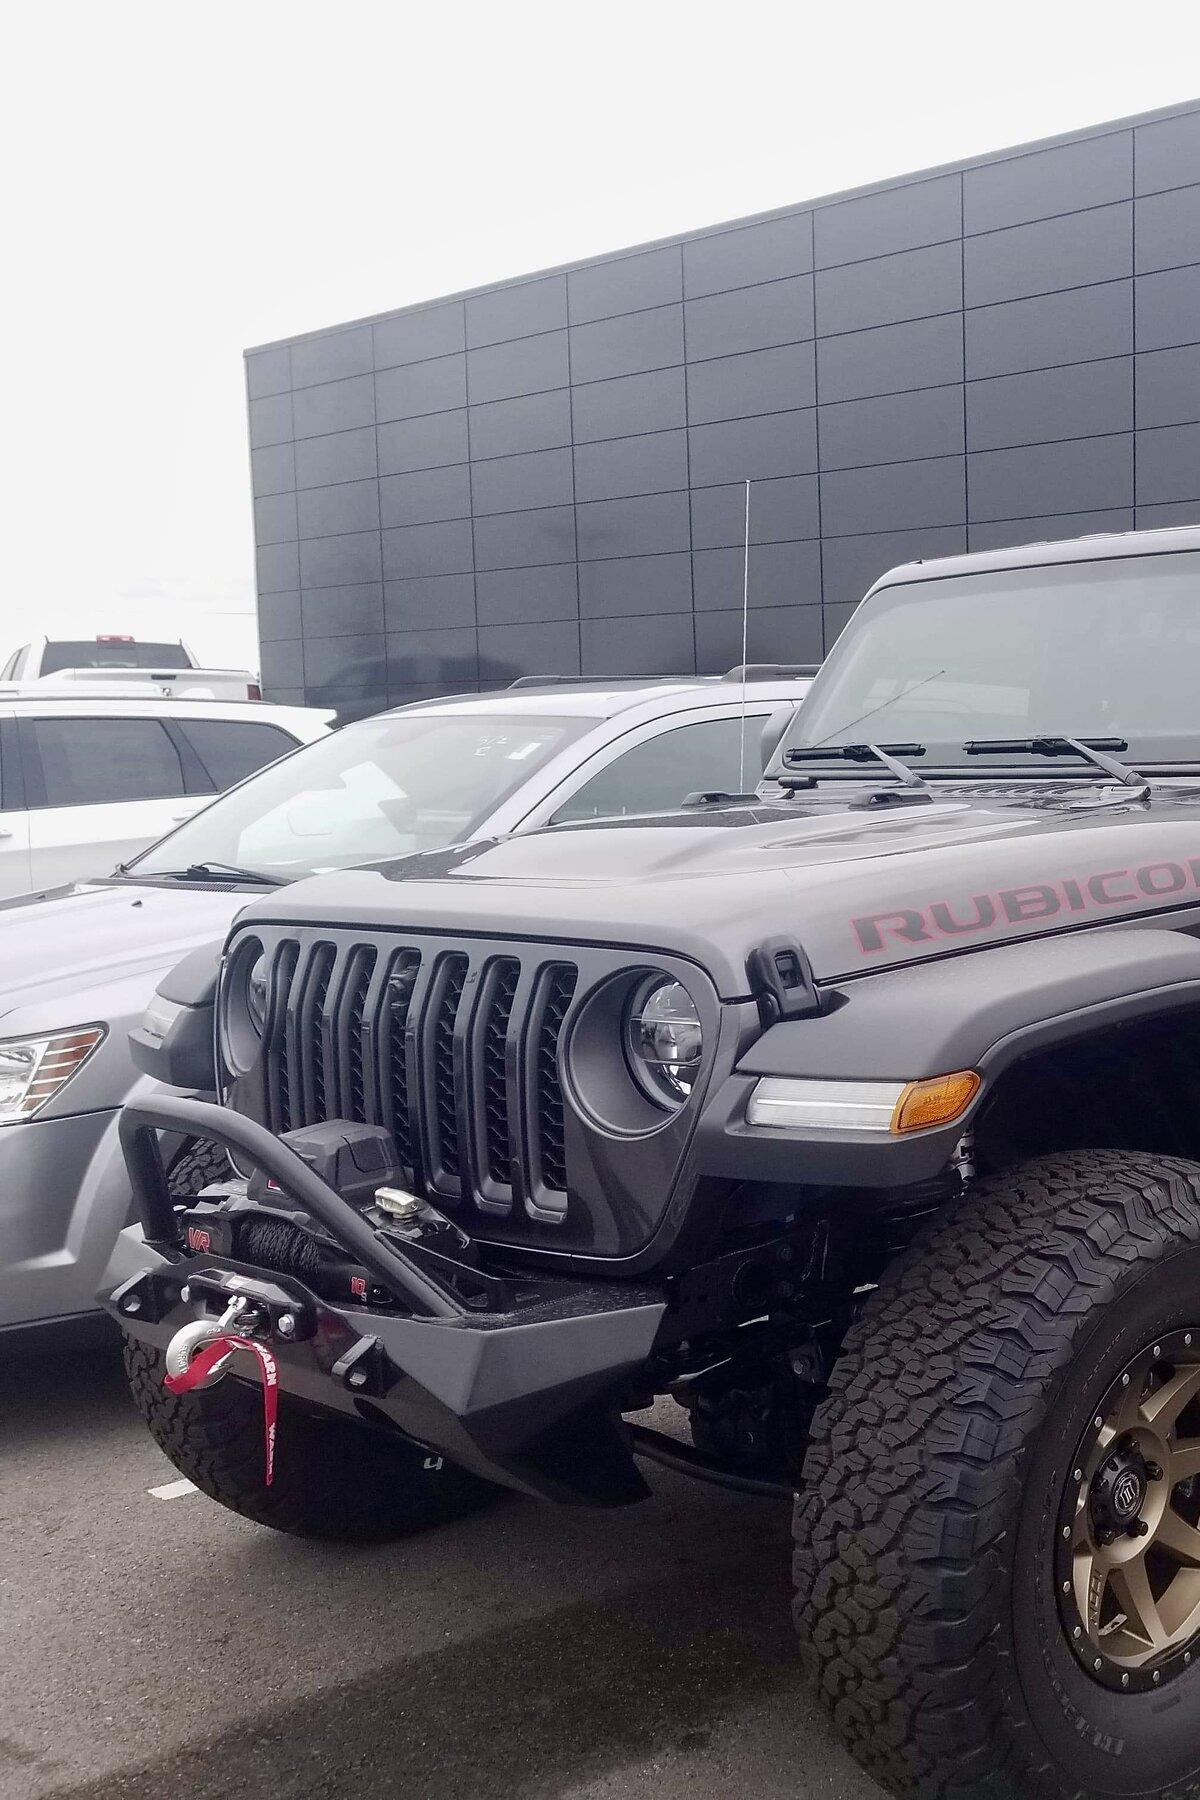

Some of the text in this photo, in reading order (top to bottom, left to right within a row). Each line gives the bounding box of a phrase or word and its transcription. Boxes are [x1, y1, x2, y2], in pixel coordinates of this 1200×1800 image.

[189, 1226, 210, 1253] VR
[351, 1276, 366, 1296] 10
[252, 1342, 277, 1386] WARN
